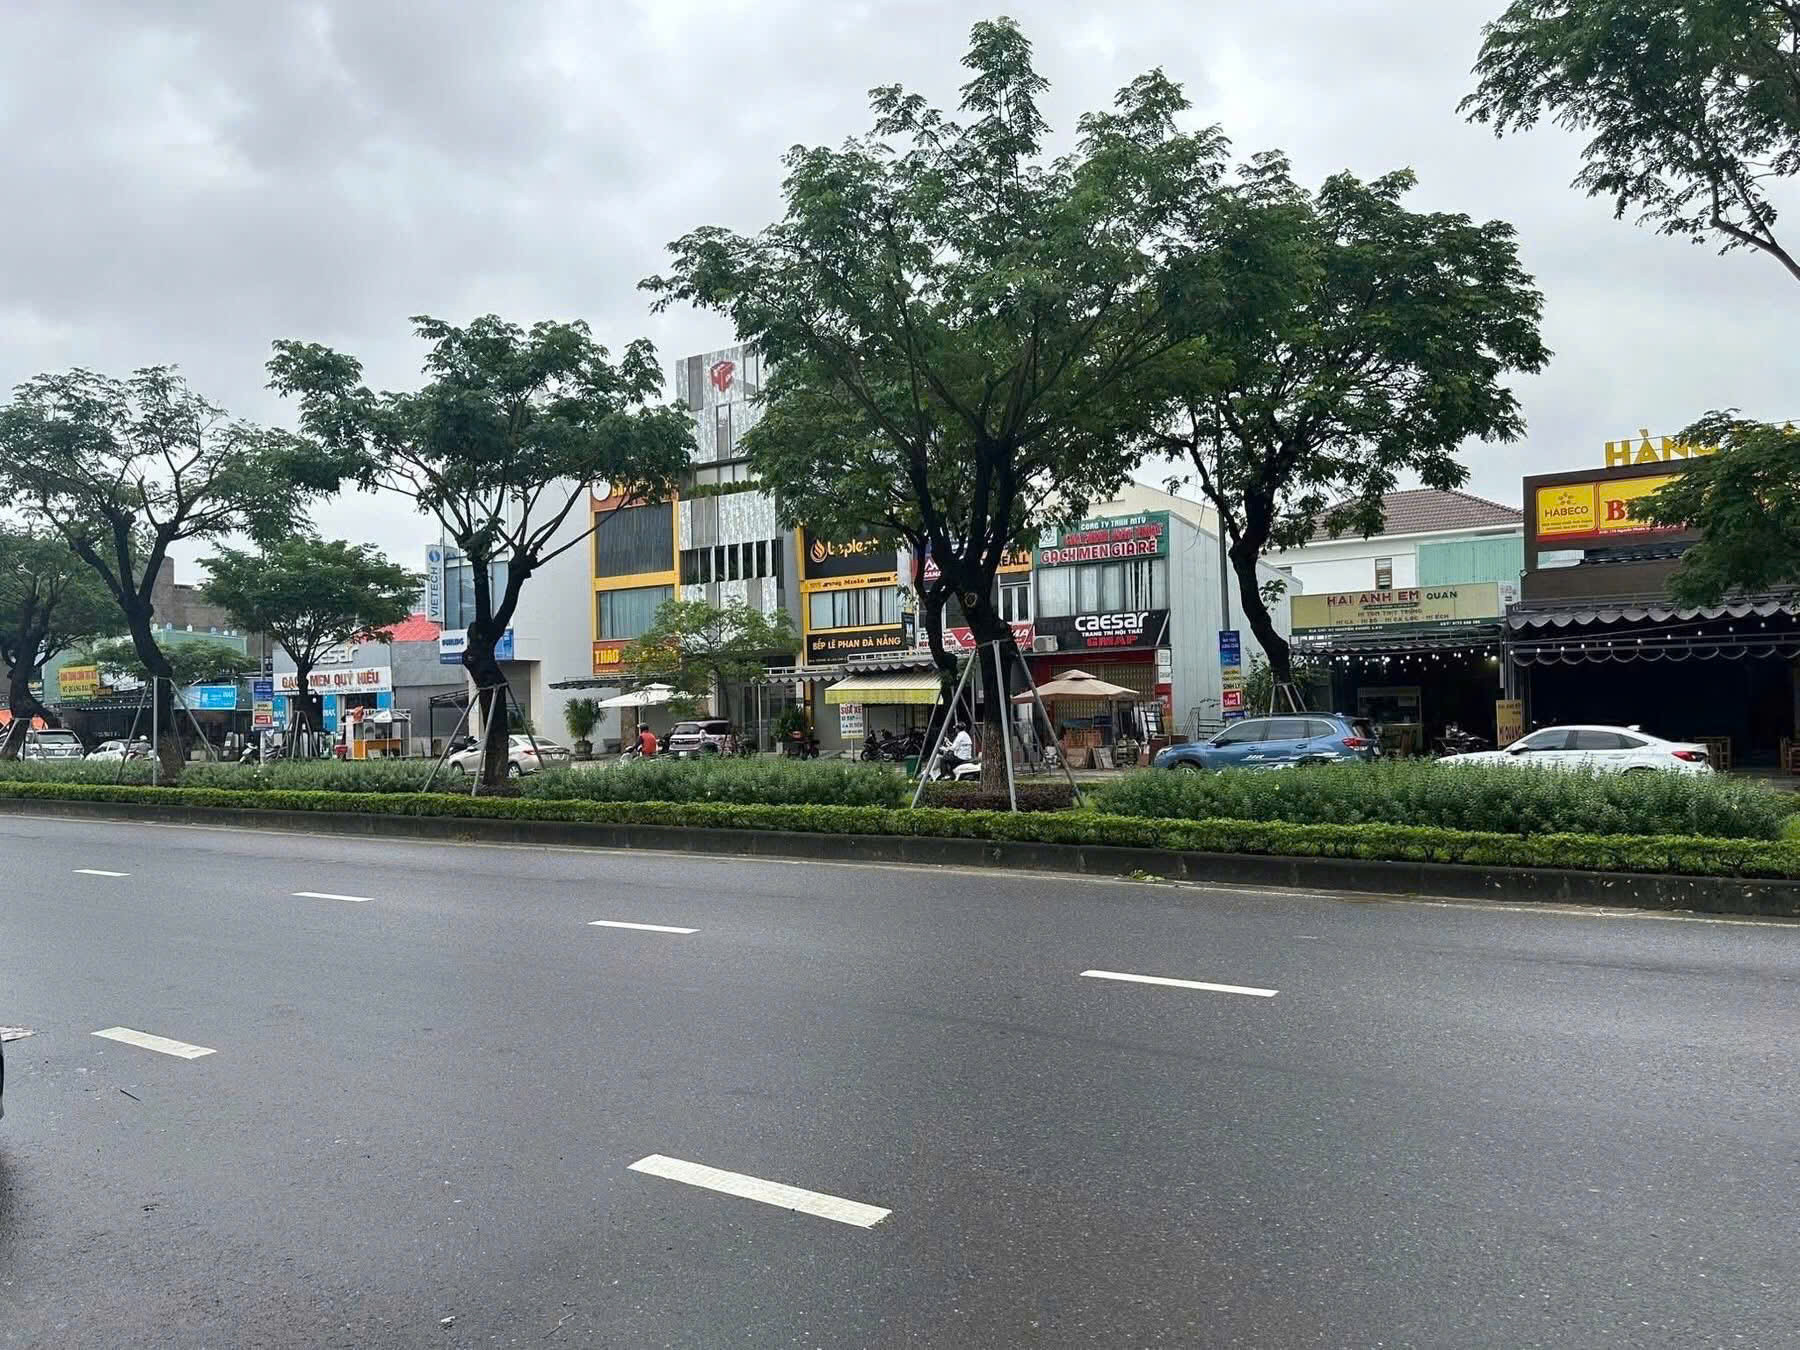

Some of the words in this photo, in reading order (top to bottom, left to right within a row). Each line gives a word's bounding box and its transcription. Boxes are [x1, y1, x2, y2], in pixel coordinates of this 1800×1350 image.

[1544, 505, 1589, 517] HABECO
[1041, 547, 1077, 566] GẠCH
[1078, 544, 1109, 561] MEN
[1110, 538, 1137, 557] GIÁ
[1137, 535, 1158, 554] RẺ
[1327, 595, 1352, 606] HAI
[1359, 592, 1392, 604] ANH
[1398, 590, 1419, 601] EM
[1426, 588, 1458, 600] QUÁN
[1074, 611, 1149, 632] caesar
[812, 638, 826, 650] BẾP
[837, 638, 860, 649] PHAN
[862, 636, 874, 648] ĐÀ
[876, 634, 902, 646] NẴNG
[309, 673, 331, 688] MEN
[357, 668, 380, 685] HIẾU
